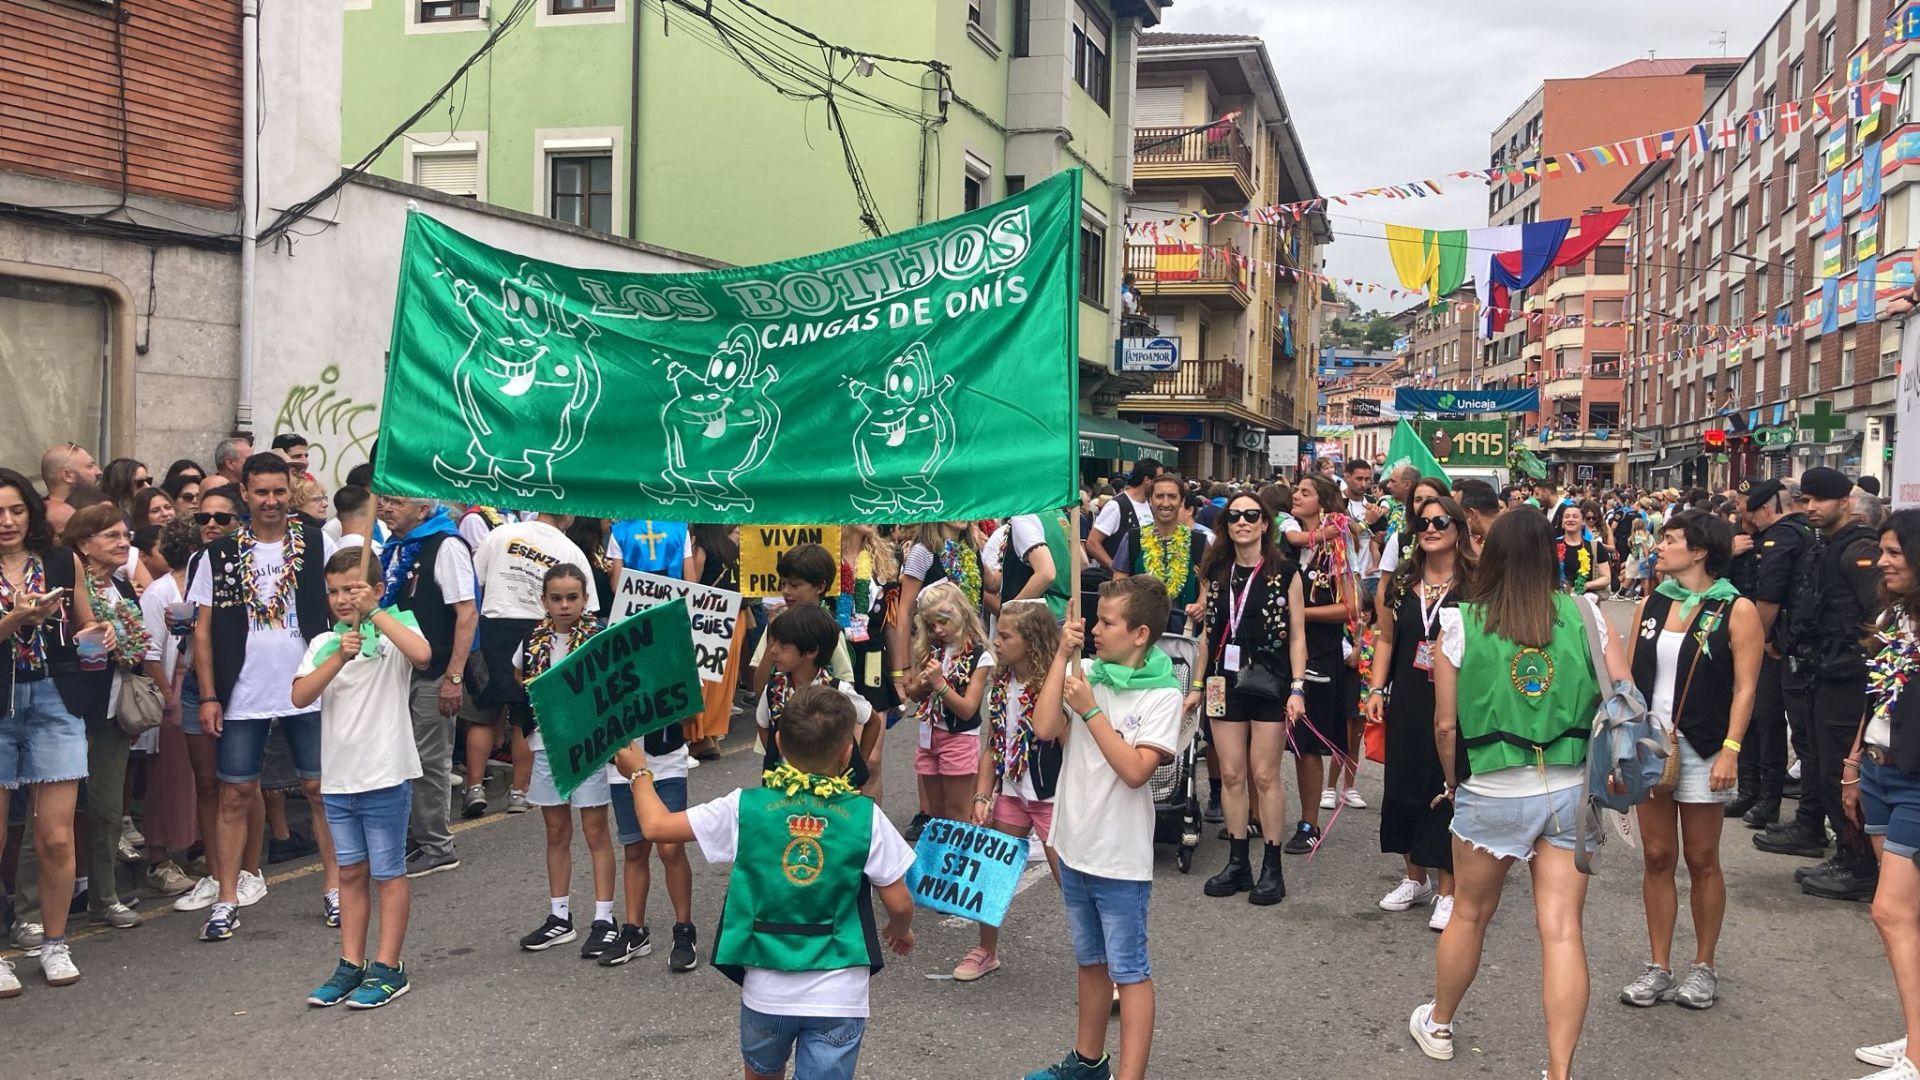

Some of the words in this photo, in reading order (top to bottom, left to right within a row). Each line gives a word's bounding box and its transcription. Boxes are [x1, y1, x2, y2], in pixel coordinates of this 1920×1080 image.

[578, 276, 718, 321] LOS
[724, 205, 1031, 321] BOTIJOS
[761, 311, 880, 349] CANGAS
[888, 300, 934, 329] DE
[944, 274, 1029, 319] ONÍS
[1125, 350, 1171, 363] CAMPOAMOR
[1457, 399, 1496, 411] Unicaja
[1452, 432, 1503, 456] 1995
[760, 528, 822, 547] VIVAN
[507, 542, 560, 568] ESENZ
[692, 613, 735, 639] GÜES
[561, 618, 654, 696] VIVAN
[593, 661, 641, 717] LES
[568, 681, 689, 775] PIRAGÜES
[928, 821, 1019, 866] PIRAGÜES
[941, 852, 982, 882] LES
[917, 875, 983, 913] VIVAN
